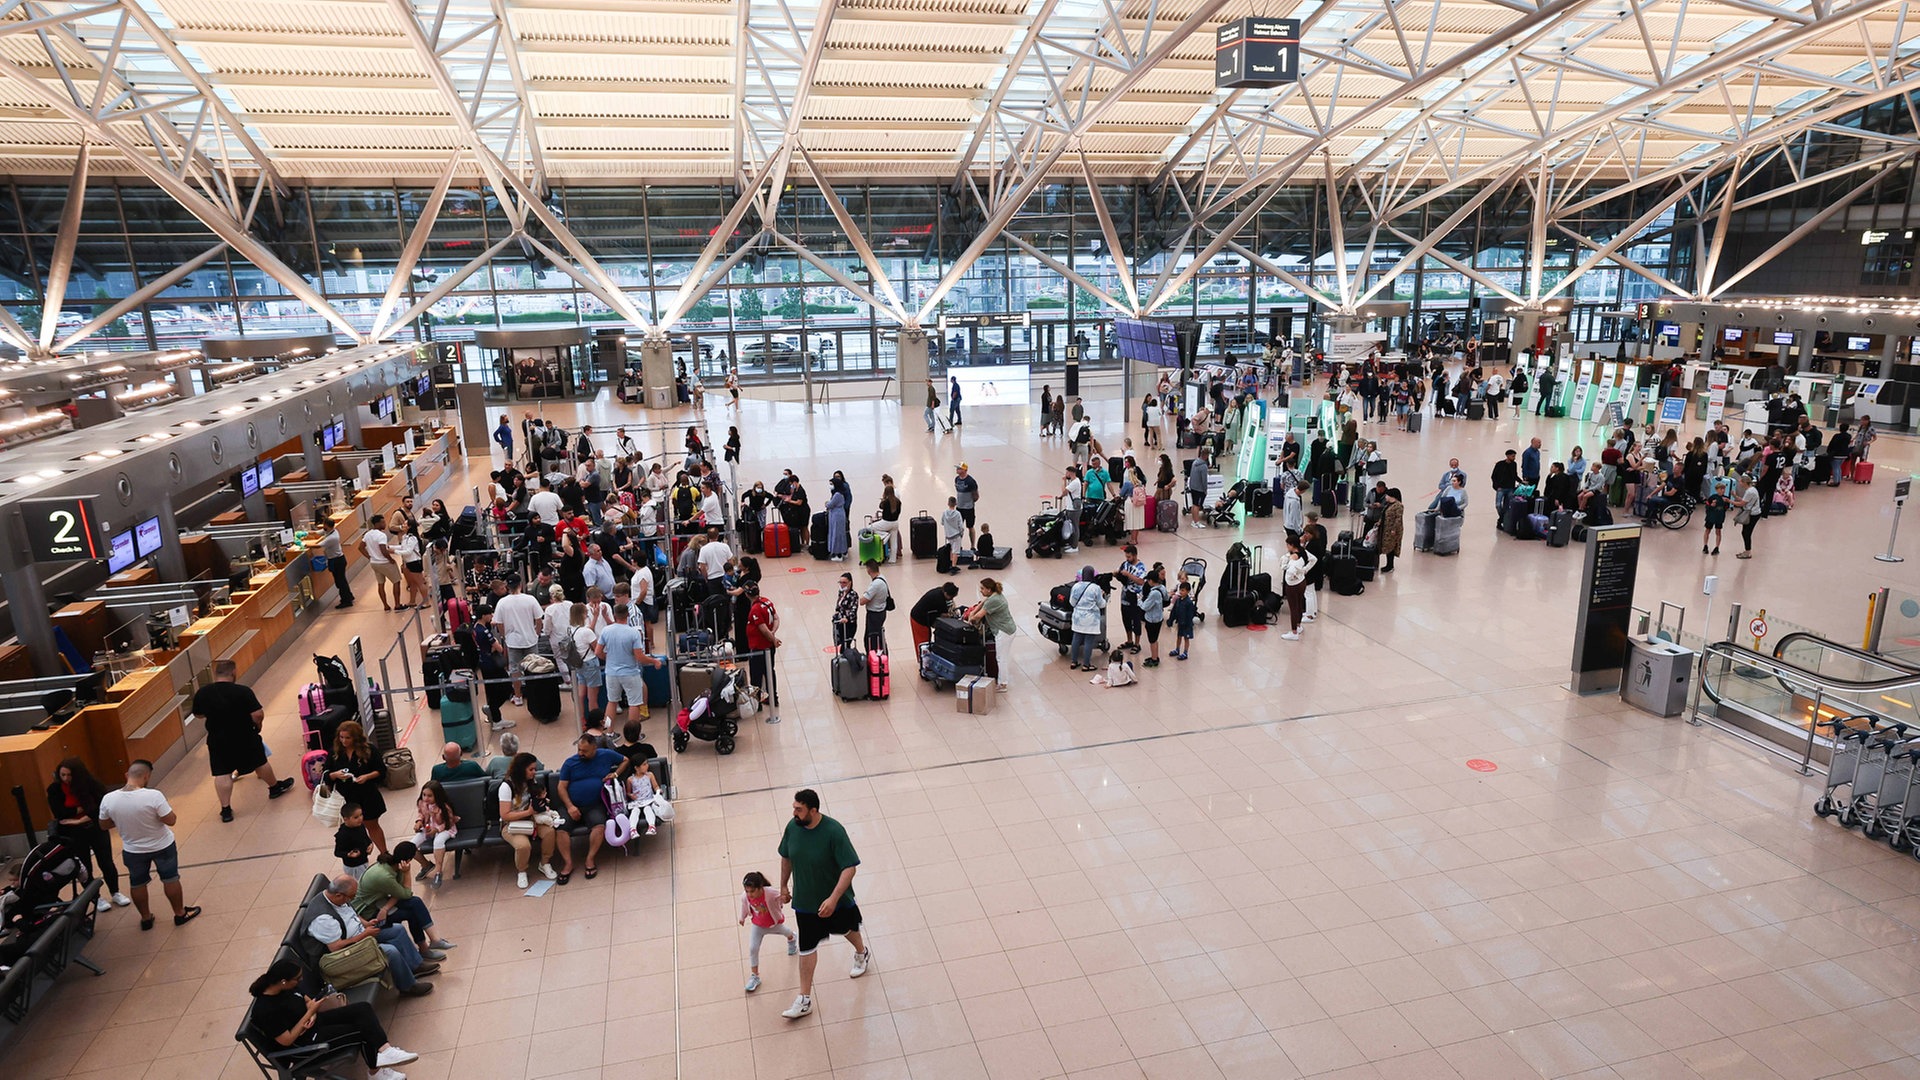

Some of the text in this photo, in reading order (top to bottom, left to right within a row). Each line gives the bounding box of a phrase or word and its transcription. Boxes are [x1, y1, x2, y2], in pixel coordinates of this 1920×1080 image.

[1232, 48, 1239, 74] 1
[1252, 47, 1288, 73] Terminal 1
[1641, 305, 1648, 315] 3
[446, 344, 457, 358] 2
[1775, 456, 1786, 469] 12
[49, 510, 80, 543] 2
[51, 546, 82, 554] Check-in
